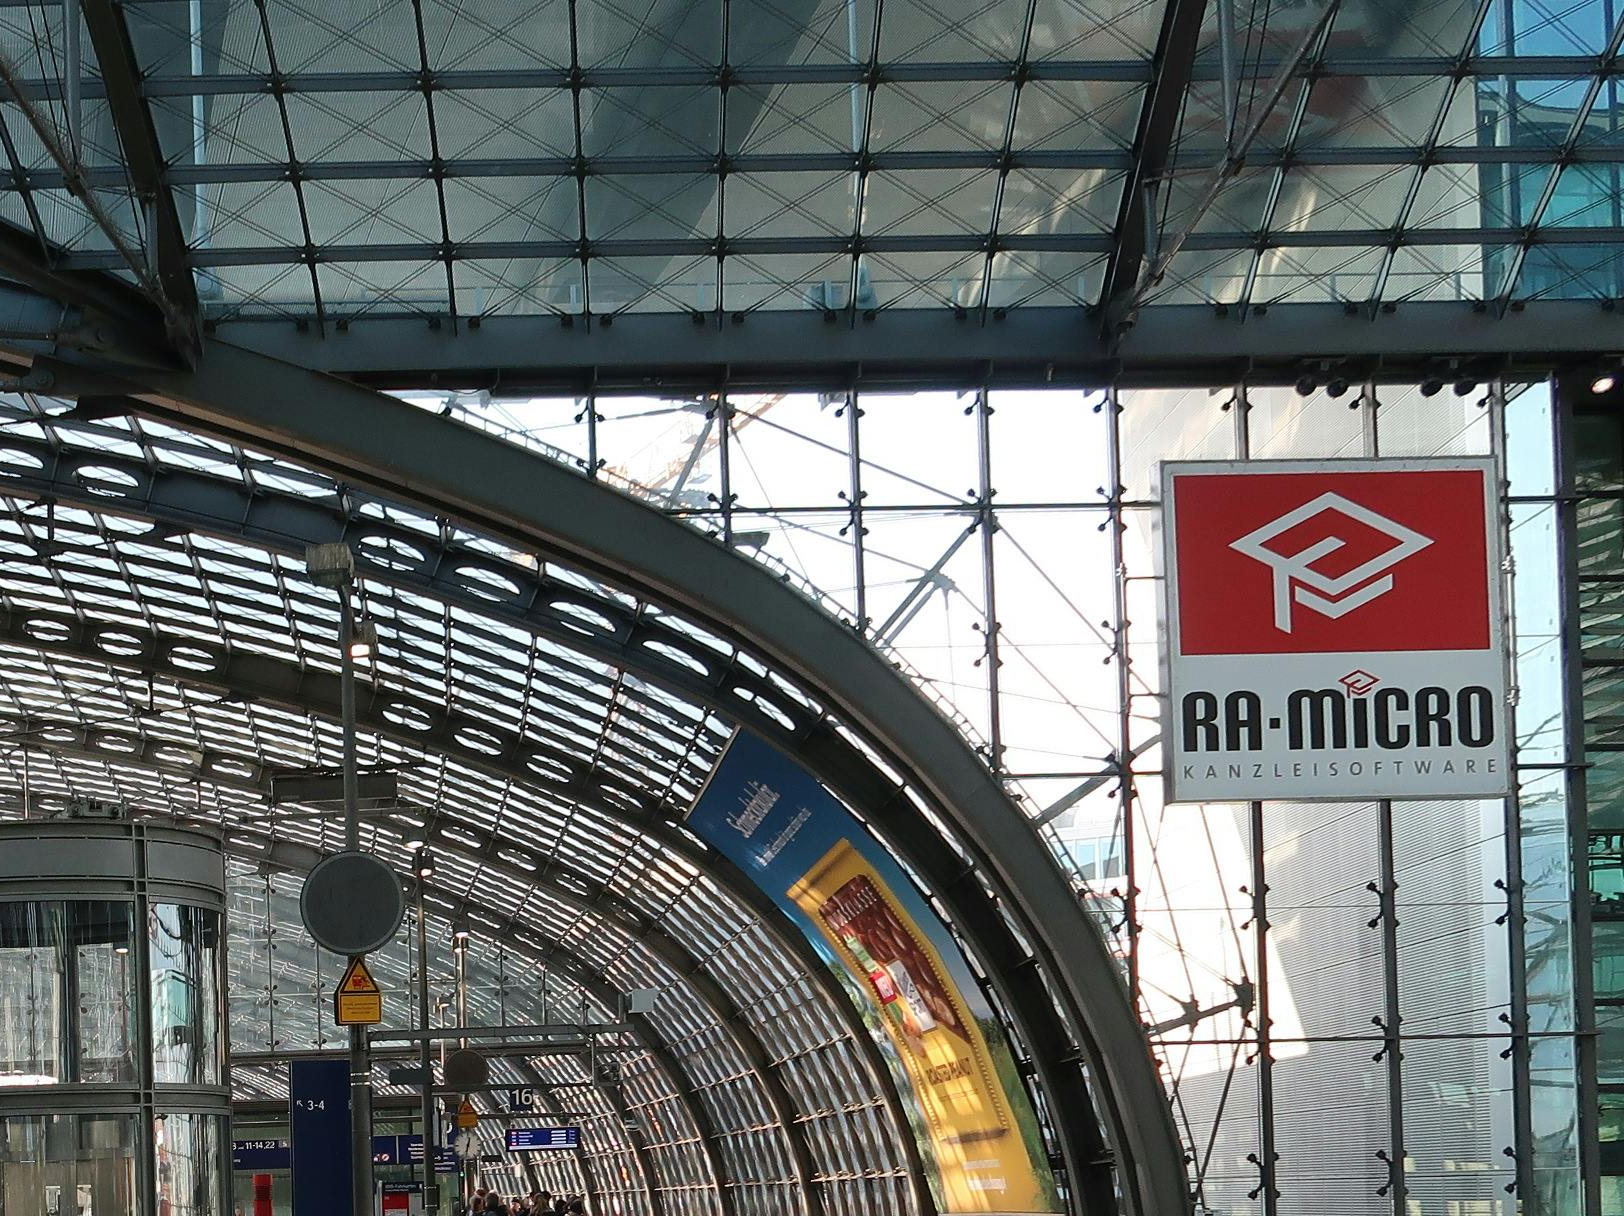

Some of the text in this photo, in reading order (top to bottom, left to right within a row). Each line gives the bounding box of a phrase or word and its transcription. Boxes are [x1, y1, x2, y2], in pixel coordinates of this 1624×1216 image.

[1183, 758, 1497, 780] KANZLEISOFTWARE
[511, 1088, 533, 1105] 16
[307, 1100, 325, 1110] 3-4
[245, 1141, 275, 1150] 11-14,22
